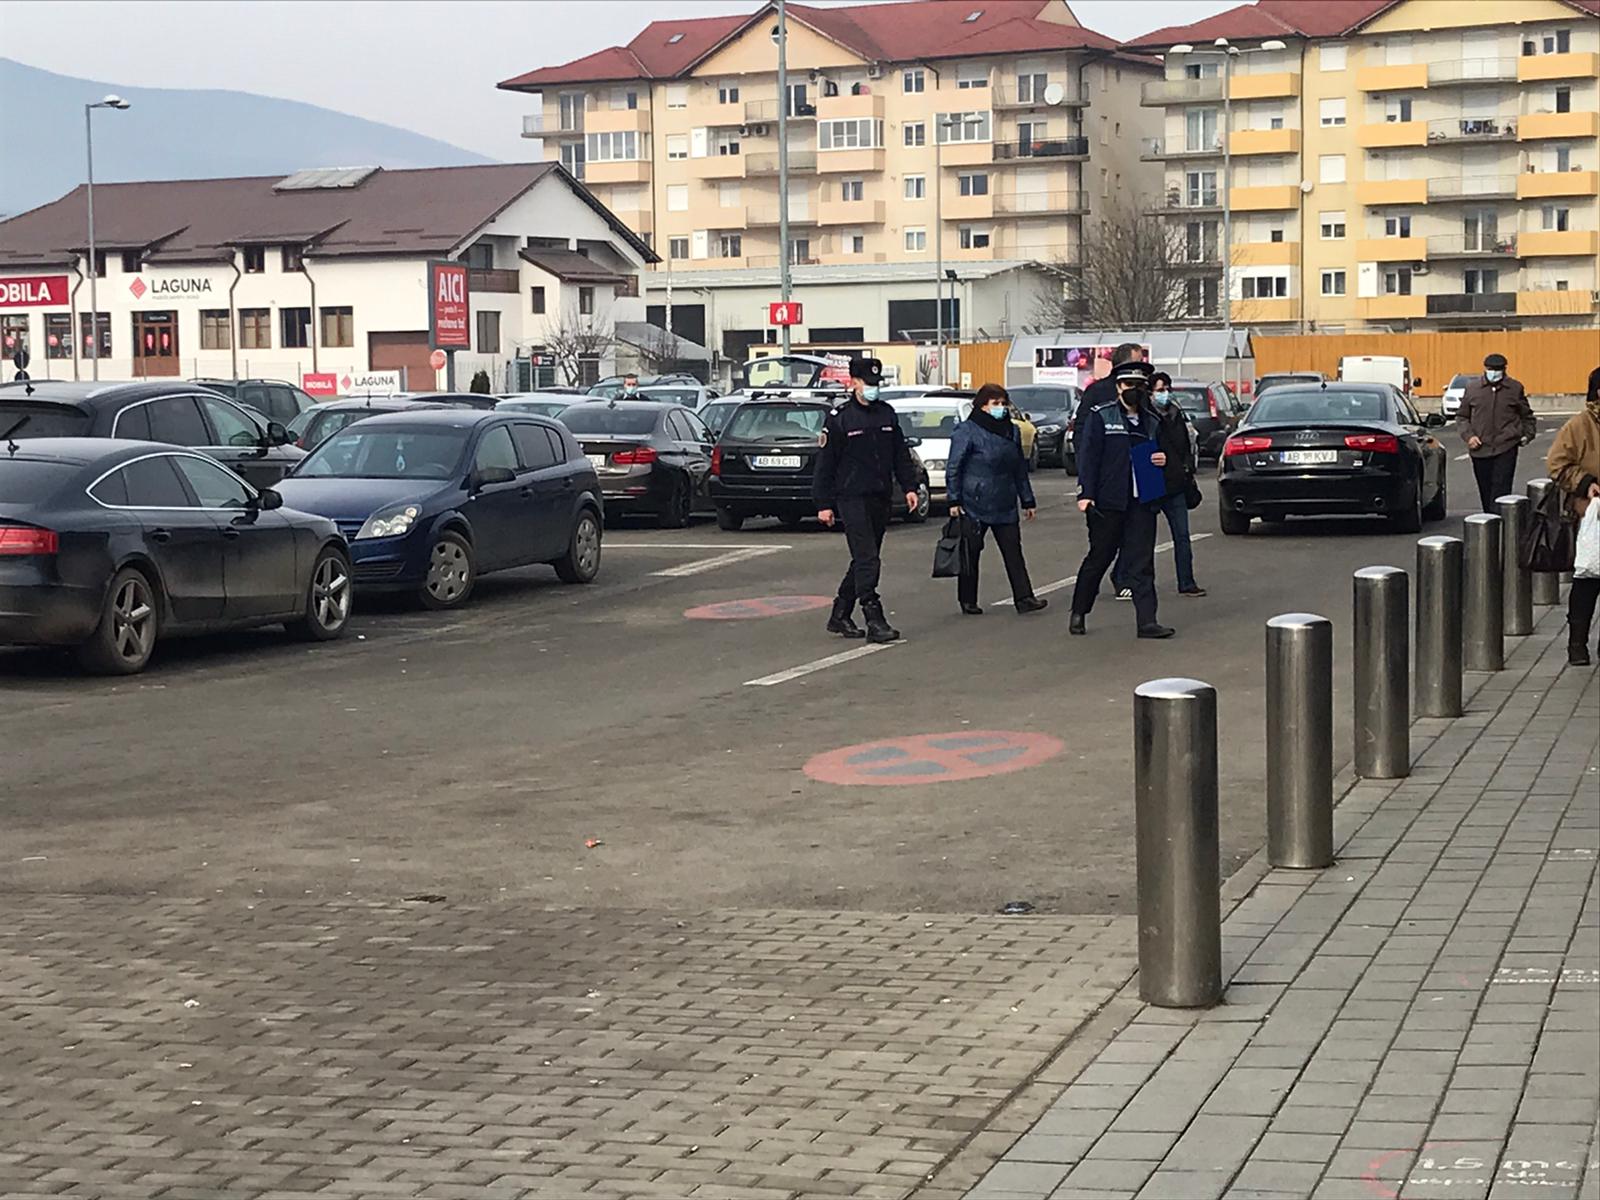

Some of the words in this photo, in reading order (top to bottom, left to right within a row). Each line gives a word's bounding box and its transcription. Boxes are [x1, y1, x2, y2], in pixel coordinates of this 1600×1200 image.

[151, 278, 212, 293] LAGUNA
[438, 272, 464, 303] AICI
[354, 375, 395, 387] LAGUNA
[758, 457, 769, 465] AB
[1287, 452, 1300, 461] AB
[1314, 451, 1335, 461] KVJ
